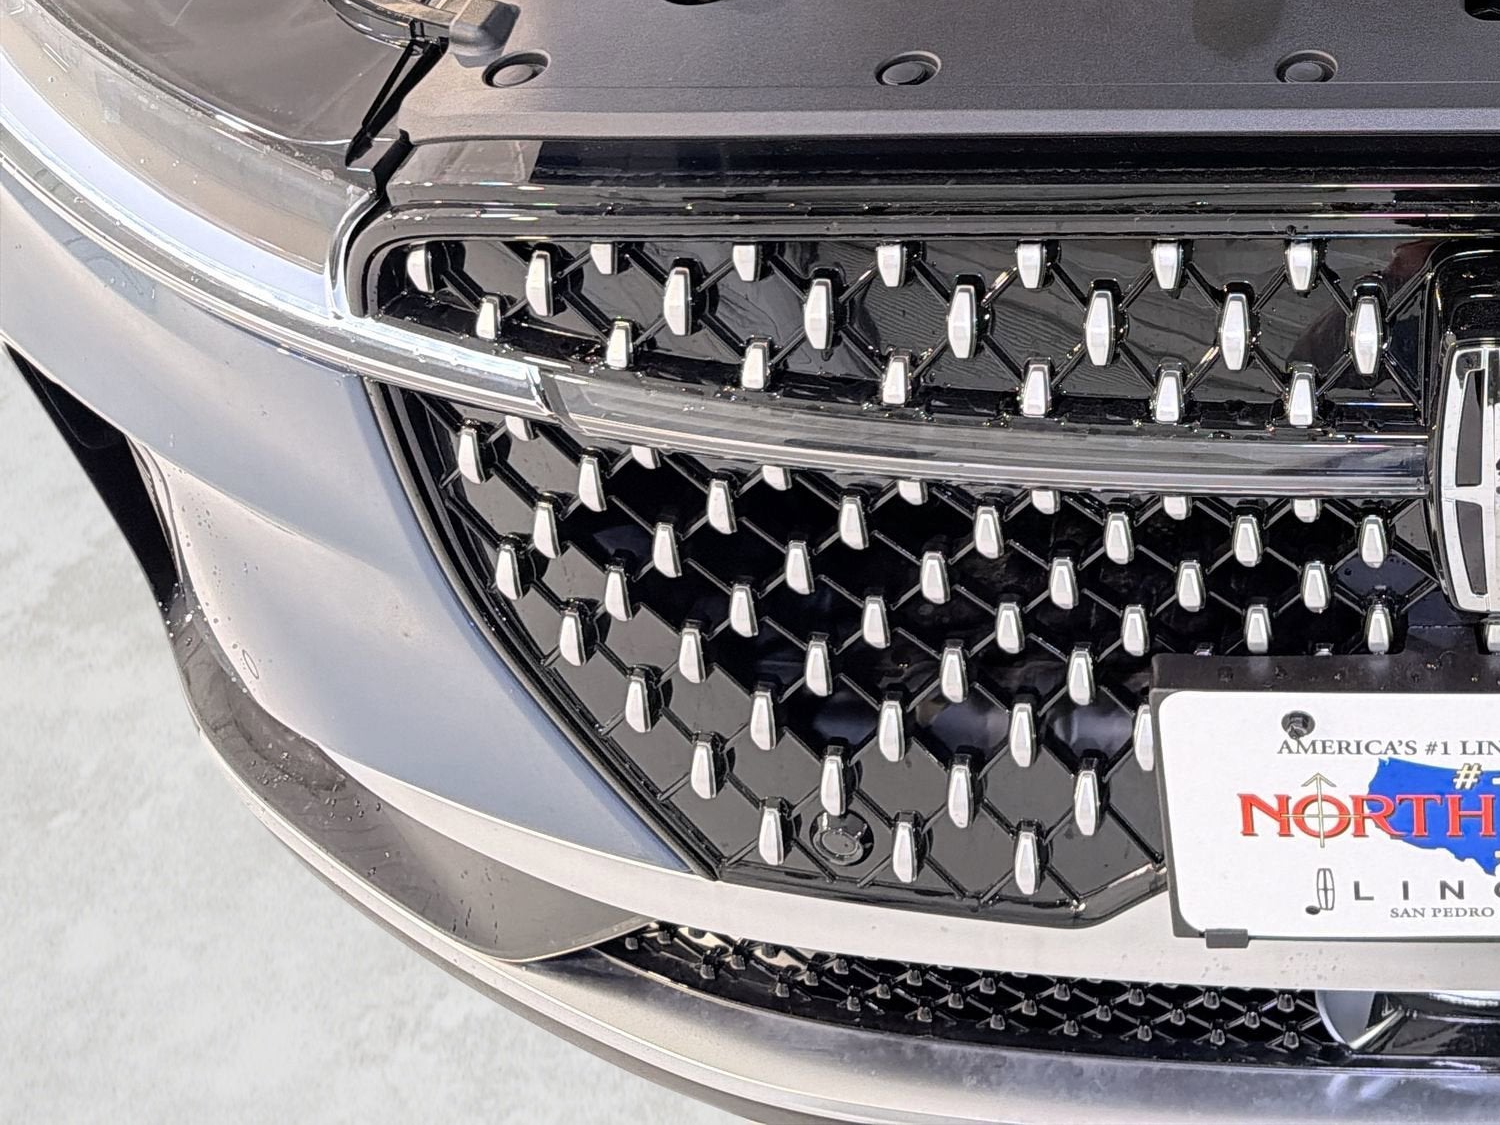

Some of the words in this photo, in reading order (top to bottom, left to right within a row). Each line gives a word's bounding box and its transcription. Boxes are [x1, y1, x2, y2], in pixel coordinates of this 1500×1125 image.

[1277, 739, 1417, 756] AMERICA'S
[1424, 740, 1451, 756] #1
[1237, 792, 1497, 839] NORTH
[1390, 907, 1426, 919] SAN
[1432, 907, 1495, 918] PEDRO
